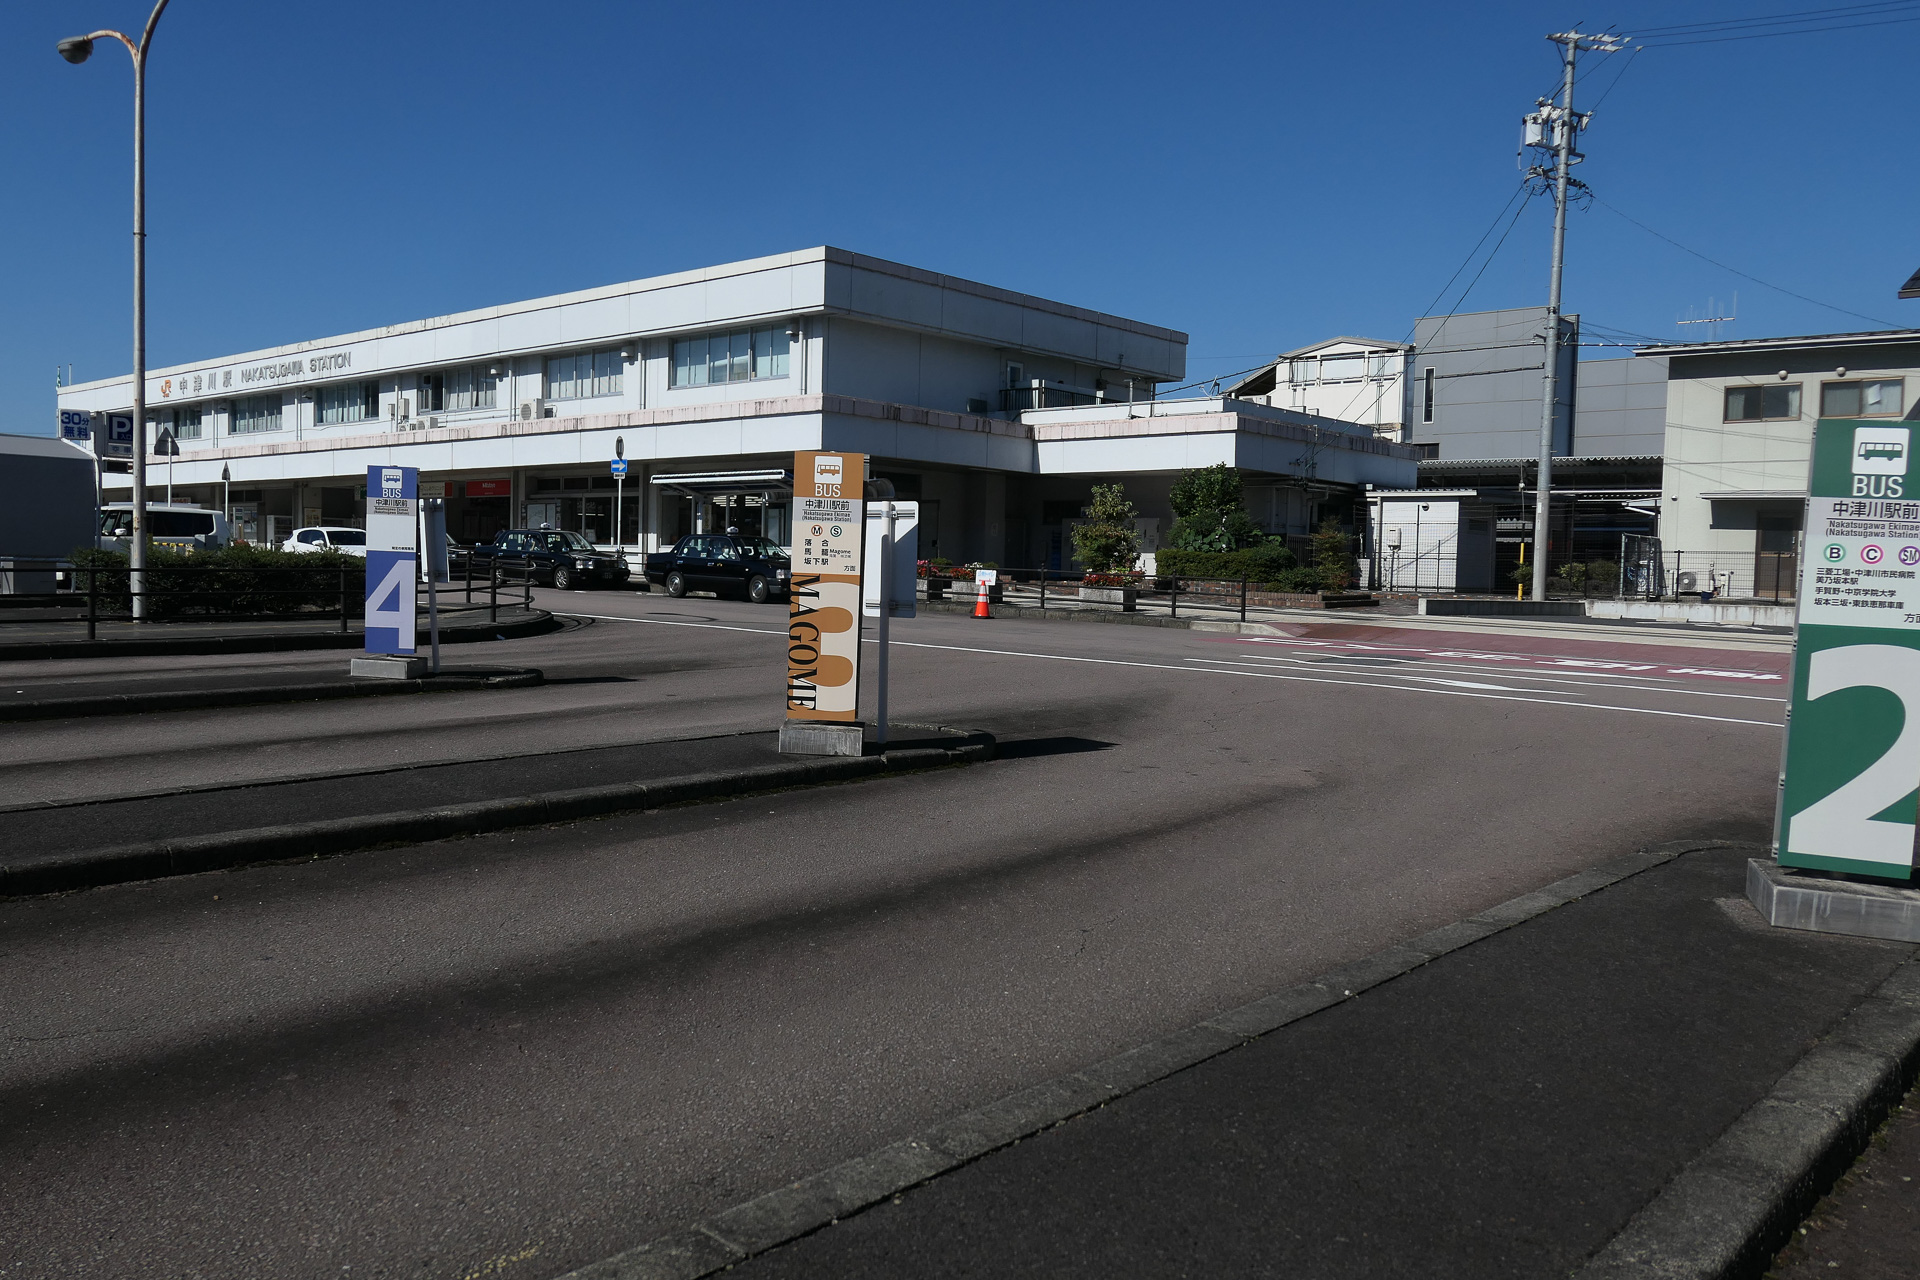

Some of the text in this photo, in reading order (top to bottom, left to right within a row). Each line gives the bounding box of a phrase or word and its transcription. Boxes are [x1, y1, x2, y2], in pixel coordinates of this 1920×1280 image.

[161, 351, 352, 395] JR 中津川駅 NAKATSUGAWA STATION
[61, 411, 90, 426] 30分
[63, 425, 89, 439] 無料
[112, 416, 131, 440] P
[382, 488, 402, 498] BUS
[815, 483, 841, 497] BUS
[1852, 475, 1903, 498] BUS
[375, 499, 408, 507] 中津川駅前
[805, 499, 850, 511] 中津川駅前
[1832, 501, 1920, 519] 中津川駅前
[1829, 520, 1920, 531] Nakatsugawa Ekimae
[1825, 528, 1886, 538] (Nakatsugawa
[804, 557, 829, 566] 坂下駅
[1829, 547, 1917, 562] B C SM
[1816, 567, 1916, 579] 三菱工場・中津川市民病院
[1815, 576, 1859, 585] 美乃坂本駅
[1815, 586, 1897, 597] 手賀野・中京学院大学
[365, 559, 416, 650] 4
[787, 573, 821, 712] MAGOME
[1787, 643, 1920, 866] 2
